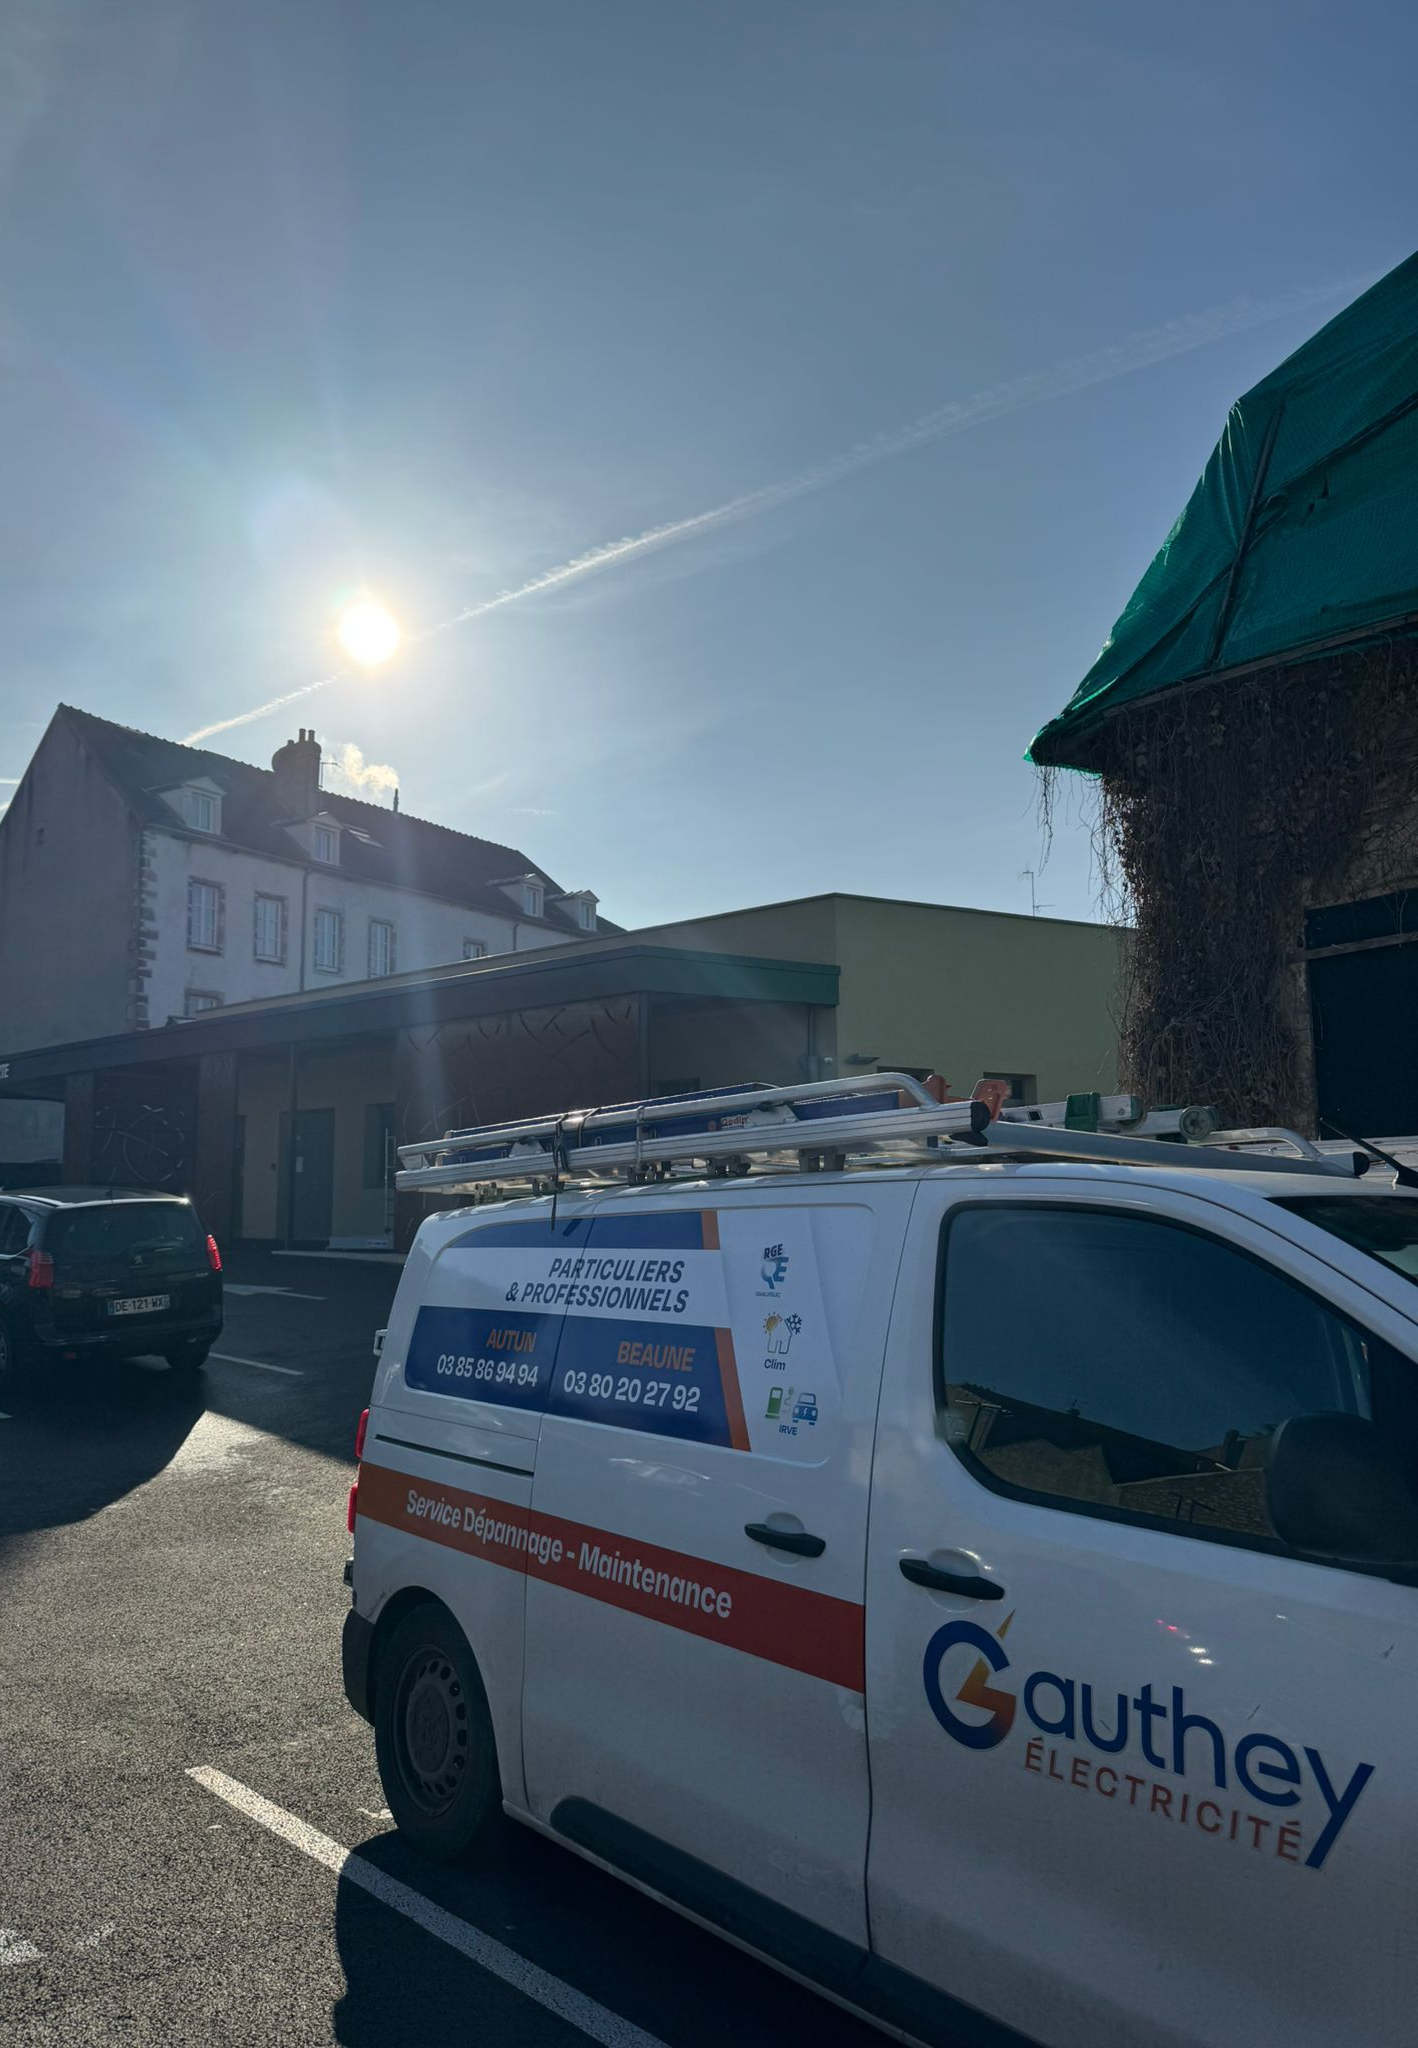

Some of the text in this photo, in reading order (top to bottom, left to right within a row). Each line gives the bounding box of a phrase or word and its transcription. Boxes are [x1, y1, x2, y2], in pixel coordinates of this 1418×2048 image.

[763, 1243, 783, 1259] RGE
[548, 1258, 685, 1283] PARTICULIERS
[505, 1281, 690, 1313] & PROFESSIONNELS
[486, 1328, 537, 1352] AUTUN
[617, 1340, 696, 1372] BEAUNE
[437, 1354, 538, 1387] 03 85 86 94 94
[764, 1358, 786, 1371] Clim
[563, 1369, 701, 1412] 03 80 20 27 92
[779, 1424, 797, 1436] IRVE
[406, 1489, 461, 1528] Service
[464, 1507, 563, 1565] Dépannage
[578, 1542, 732, 1618] Maintenance
[922, 1618, 1376, 1869] Gauthey
[1024, 1736, 1303, 1862] ÉLECTRICITÉ
